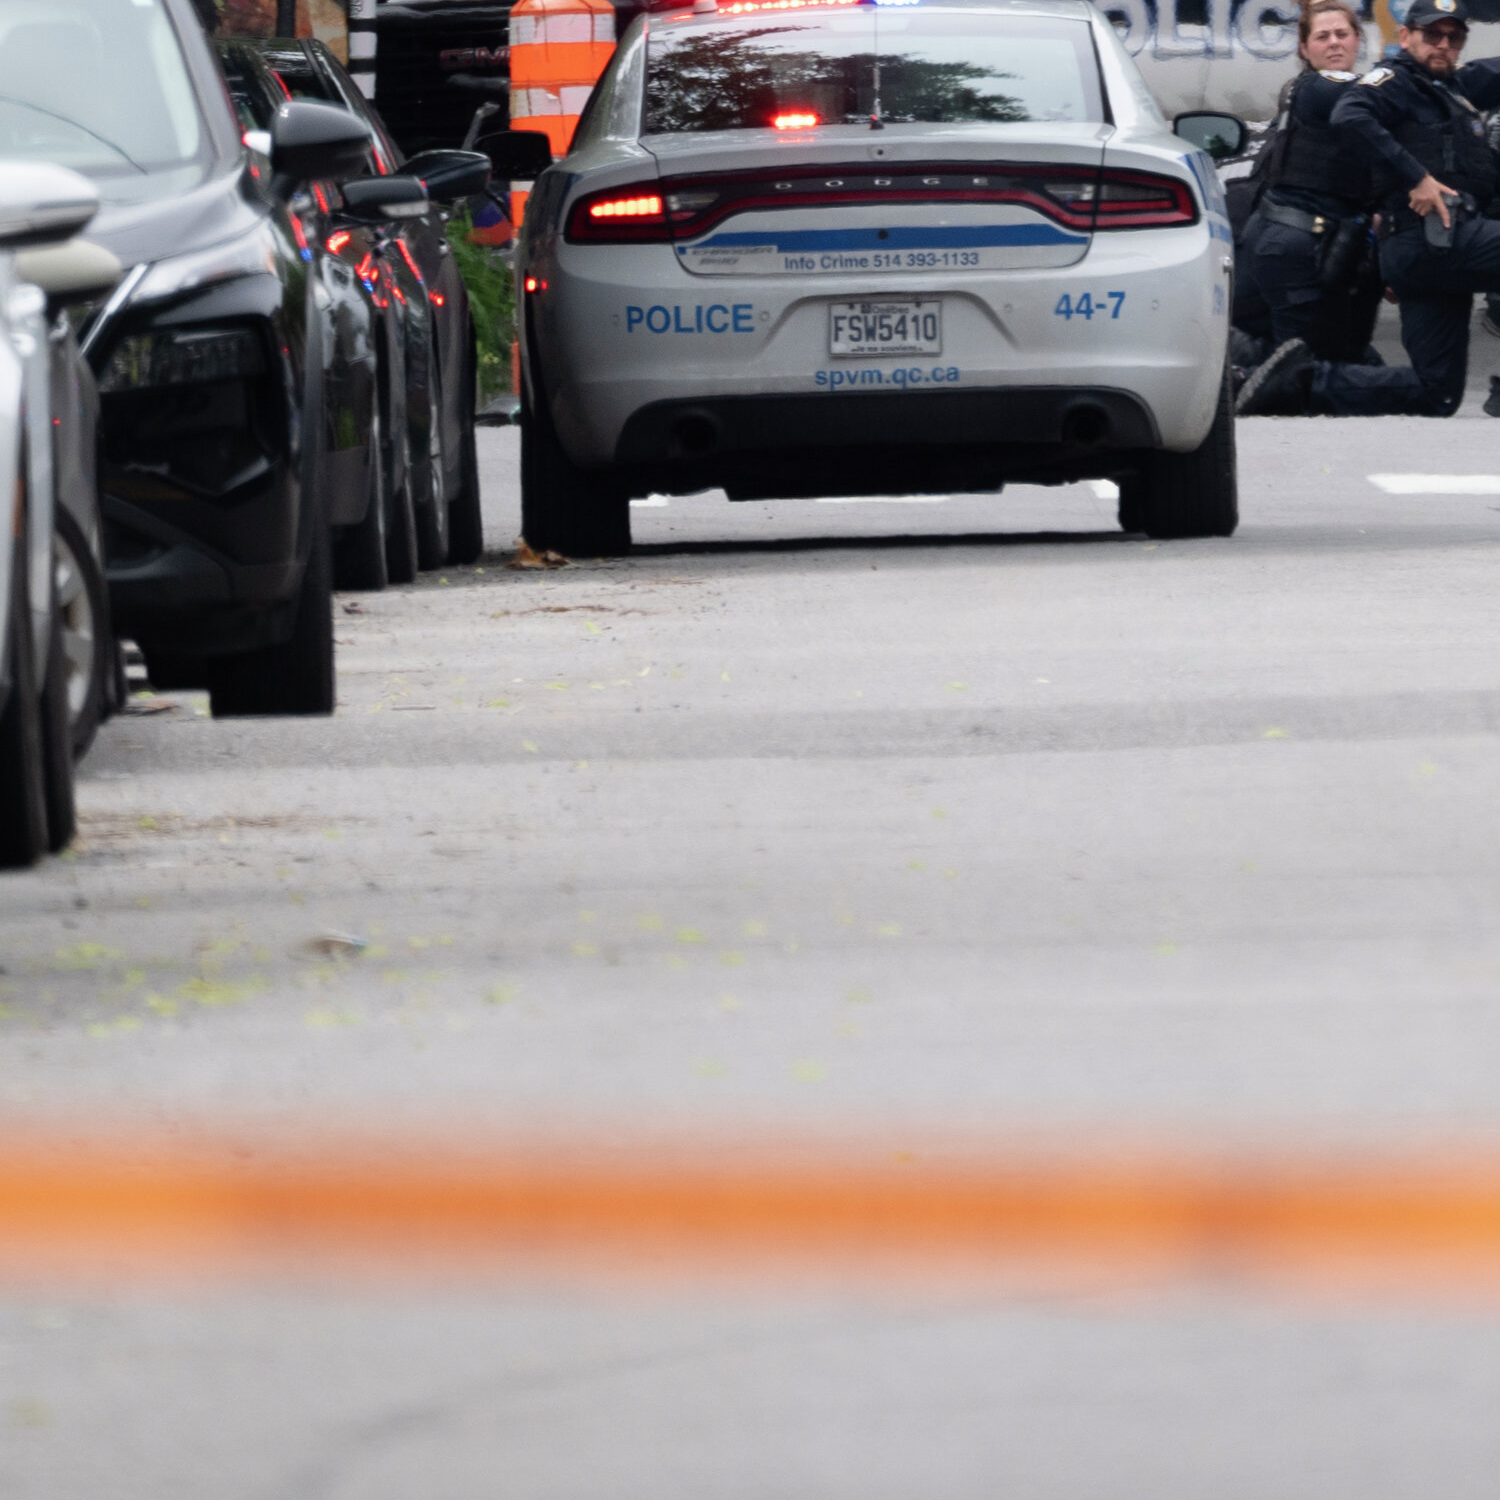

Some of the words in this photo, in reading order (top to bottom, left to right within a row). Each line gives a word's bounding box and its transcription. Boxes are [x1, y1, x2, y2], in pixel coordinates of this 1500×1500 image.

[440, 46, 511, 69] GM
[774, 176, 990, 191] DODGE
[785, 256, 815, 270] Info
[820, 254, 869, 268] Crime
[873, 254, 900, 267] 514
[906, 252, 980, 266] 393-1133
[1054, 292, 1126, 320] 44-7
[626, 304, 754, 334] POLICE
[833, 313, 938, 342] FSW5410
[814, 365, 961, 390] spvm.qc.ca
